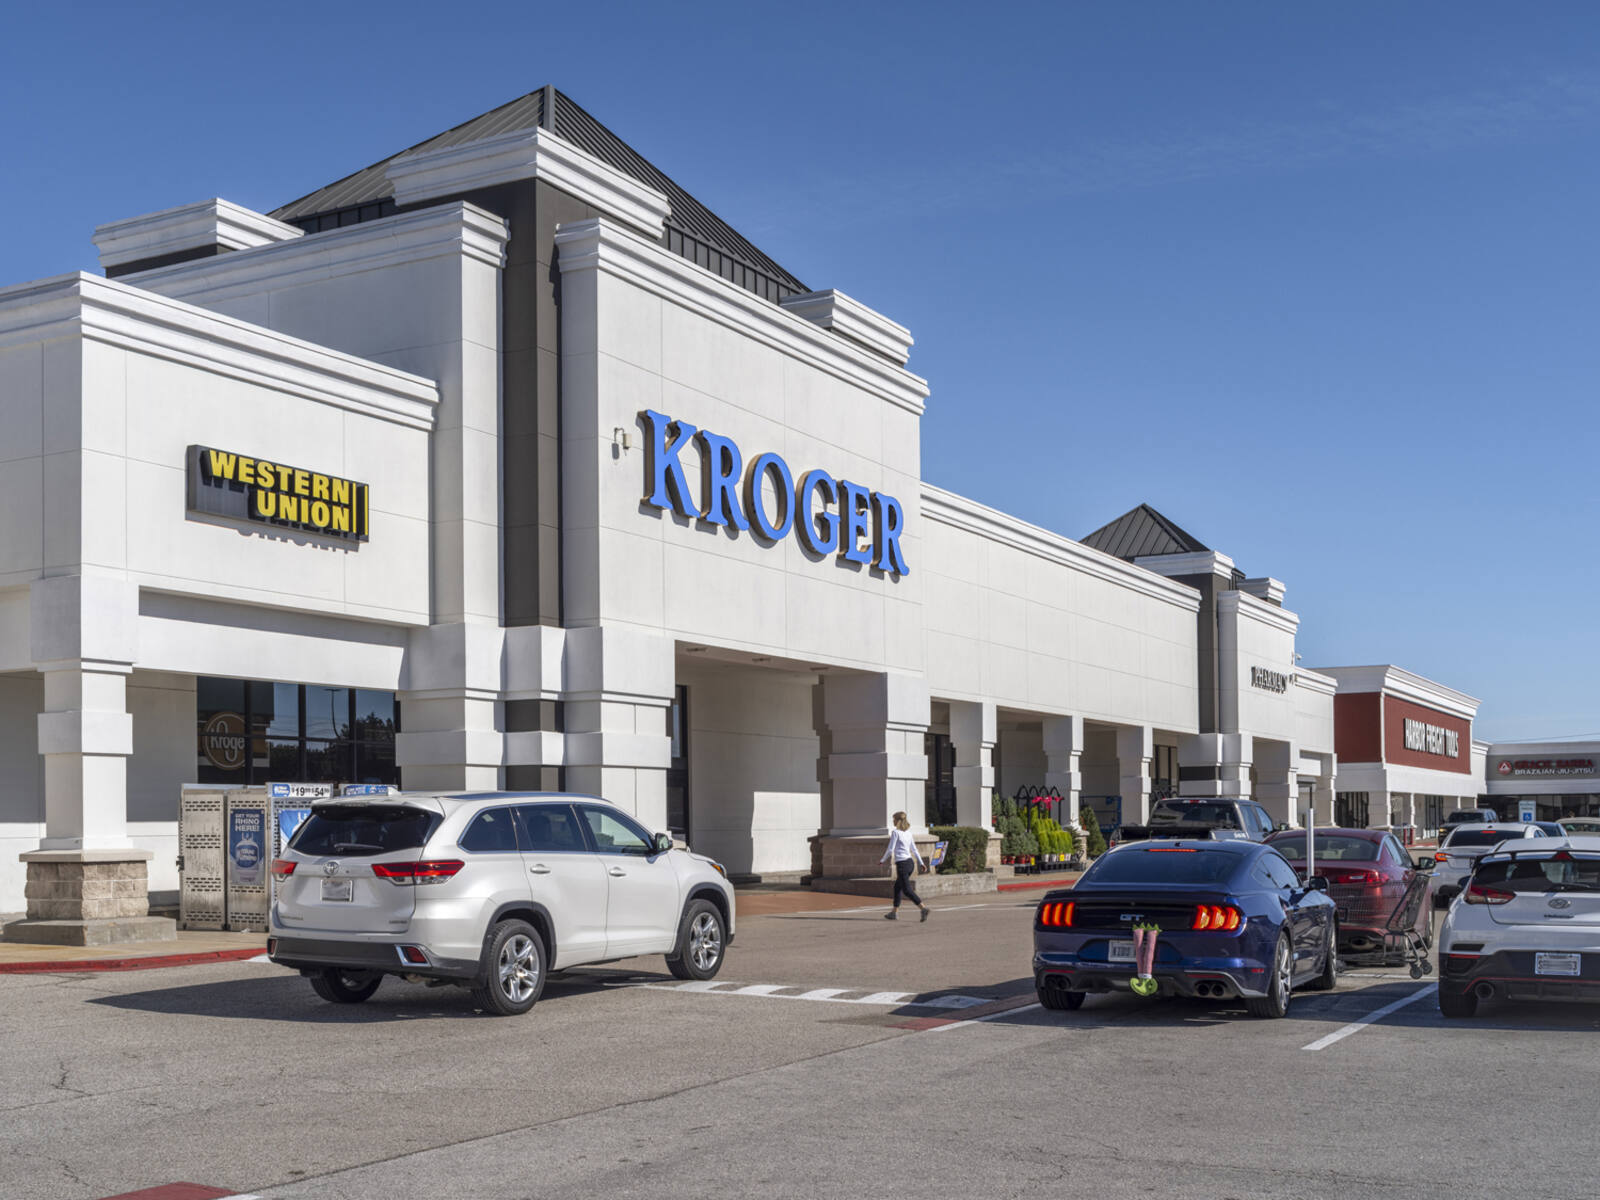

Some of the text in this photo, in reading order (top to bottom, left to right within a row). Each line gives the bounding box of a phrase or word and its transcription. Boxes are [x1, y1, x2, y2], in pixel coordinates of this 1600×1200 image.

[209, 449, 350, 505] WESTERN
[638, 408, 910, 577] KROGER
[257, 489, 350, 532] UNION
[1251, 666, 1287, 694] PHARMACY
[1404, 718, 1459, 758] HARBOR FREIGHT TOOLS
[1120, 913, 1145, 921] GT
